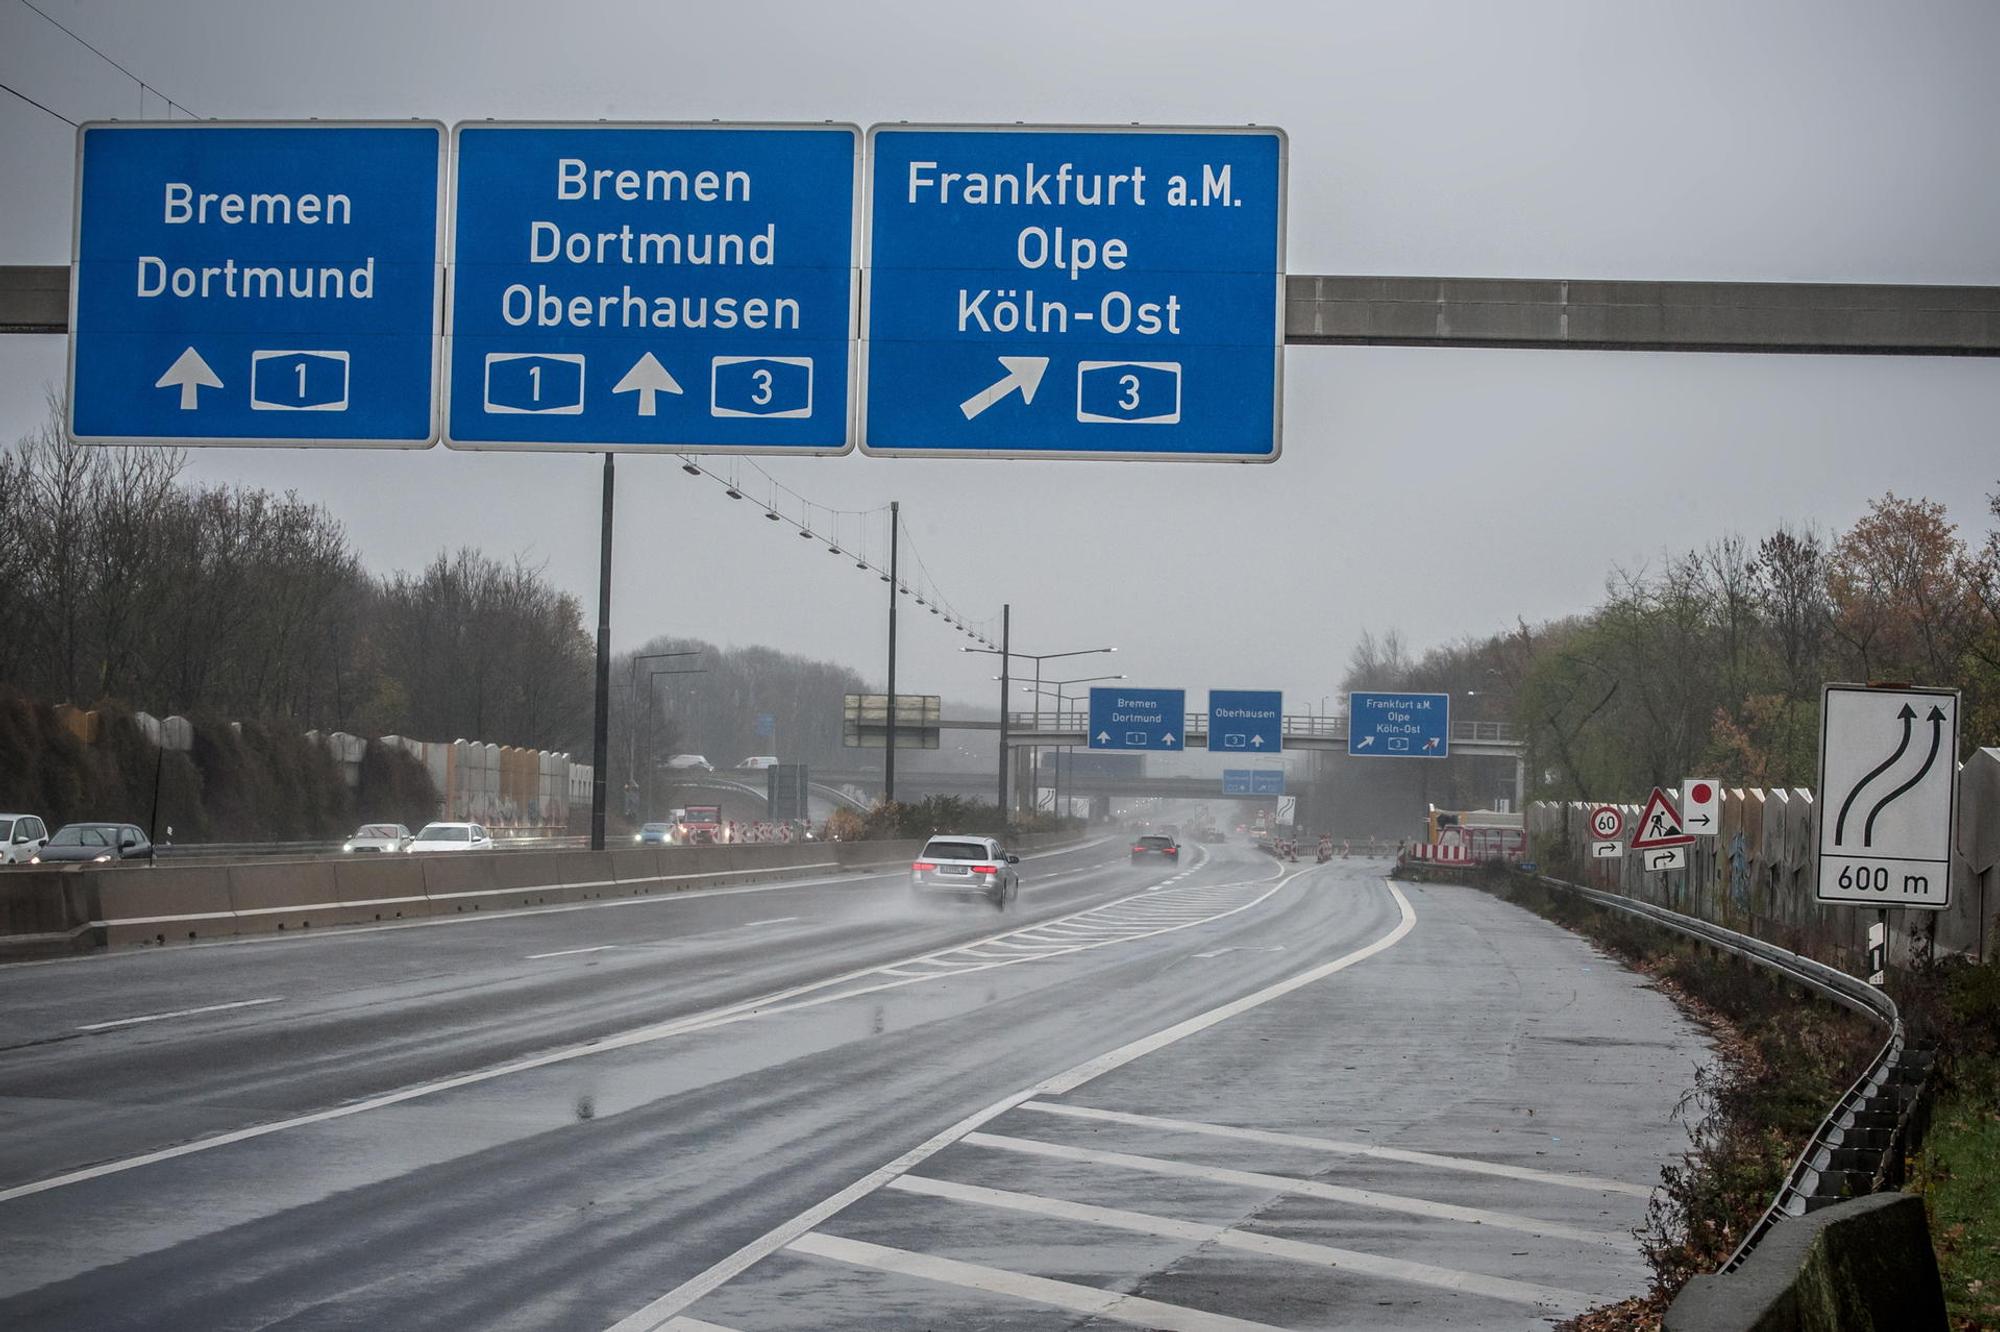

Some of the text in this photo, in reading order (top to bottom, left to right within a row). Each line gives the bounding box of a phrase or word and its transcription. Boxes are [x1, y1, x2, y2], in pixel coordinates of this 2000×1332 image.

[558, 159, 750, 202] Bremen
[908, 161, 1242, 207] Frankfurt a.M.
[164, 183, 351, 225] Bremen
[530, 222, 775, 266] Dortmund
[1017, 226, 1128, 280] Olpe
[137, 256, 375, 299] Dortmund
[502, 283, 800, 330] Oberhausen
[958, 289, 1181, 335] Köln-Ost
[294, 363, 307, 399] 1
[529, 366, 541, 402] 1
[750, 369, 773, 406] 3
[1118, 374, 1141, 411] 3
[1112, 712, 1162, 723] Dortmund
[1117, 698, 1157, 709] Bremen
[1215, 707, 1275, 719] Oberhausen
[1366, 699, 1413, 709] Frankfurt
[1387, 711, 1411, 722] Olpe
[1376, 723, 1421, 734] Köln-Ost
[1598, 816, 1615, 830] 60
[1838, 865, 1929, 895] 600 m
